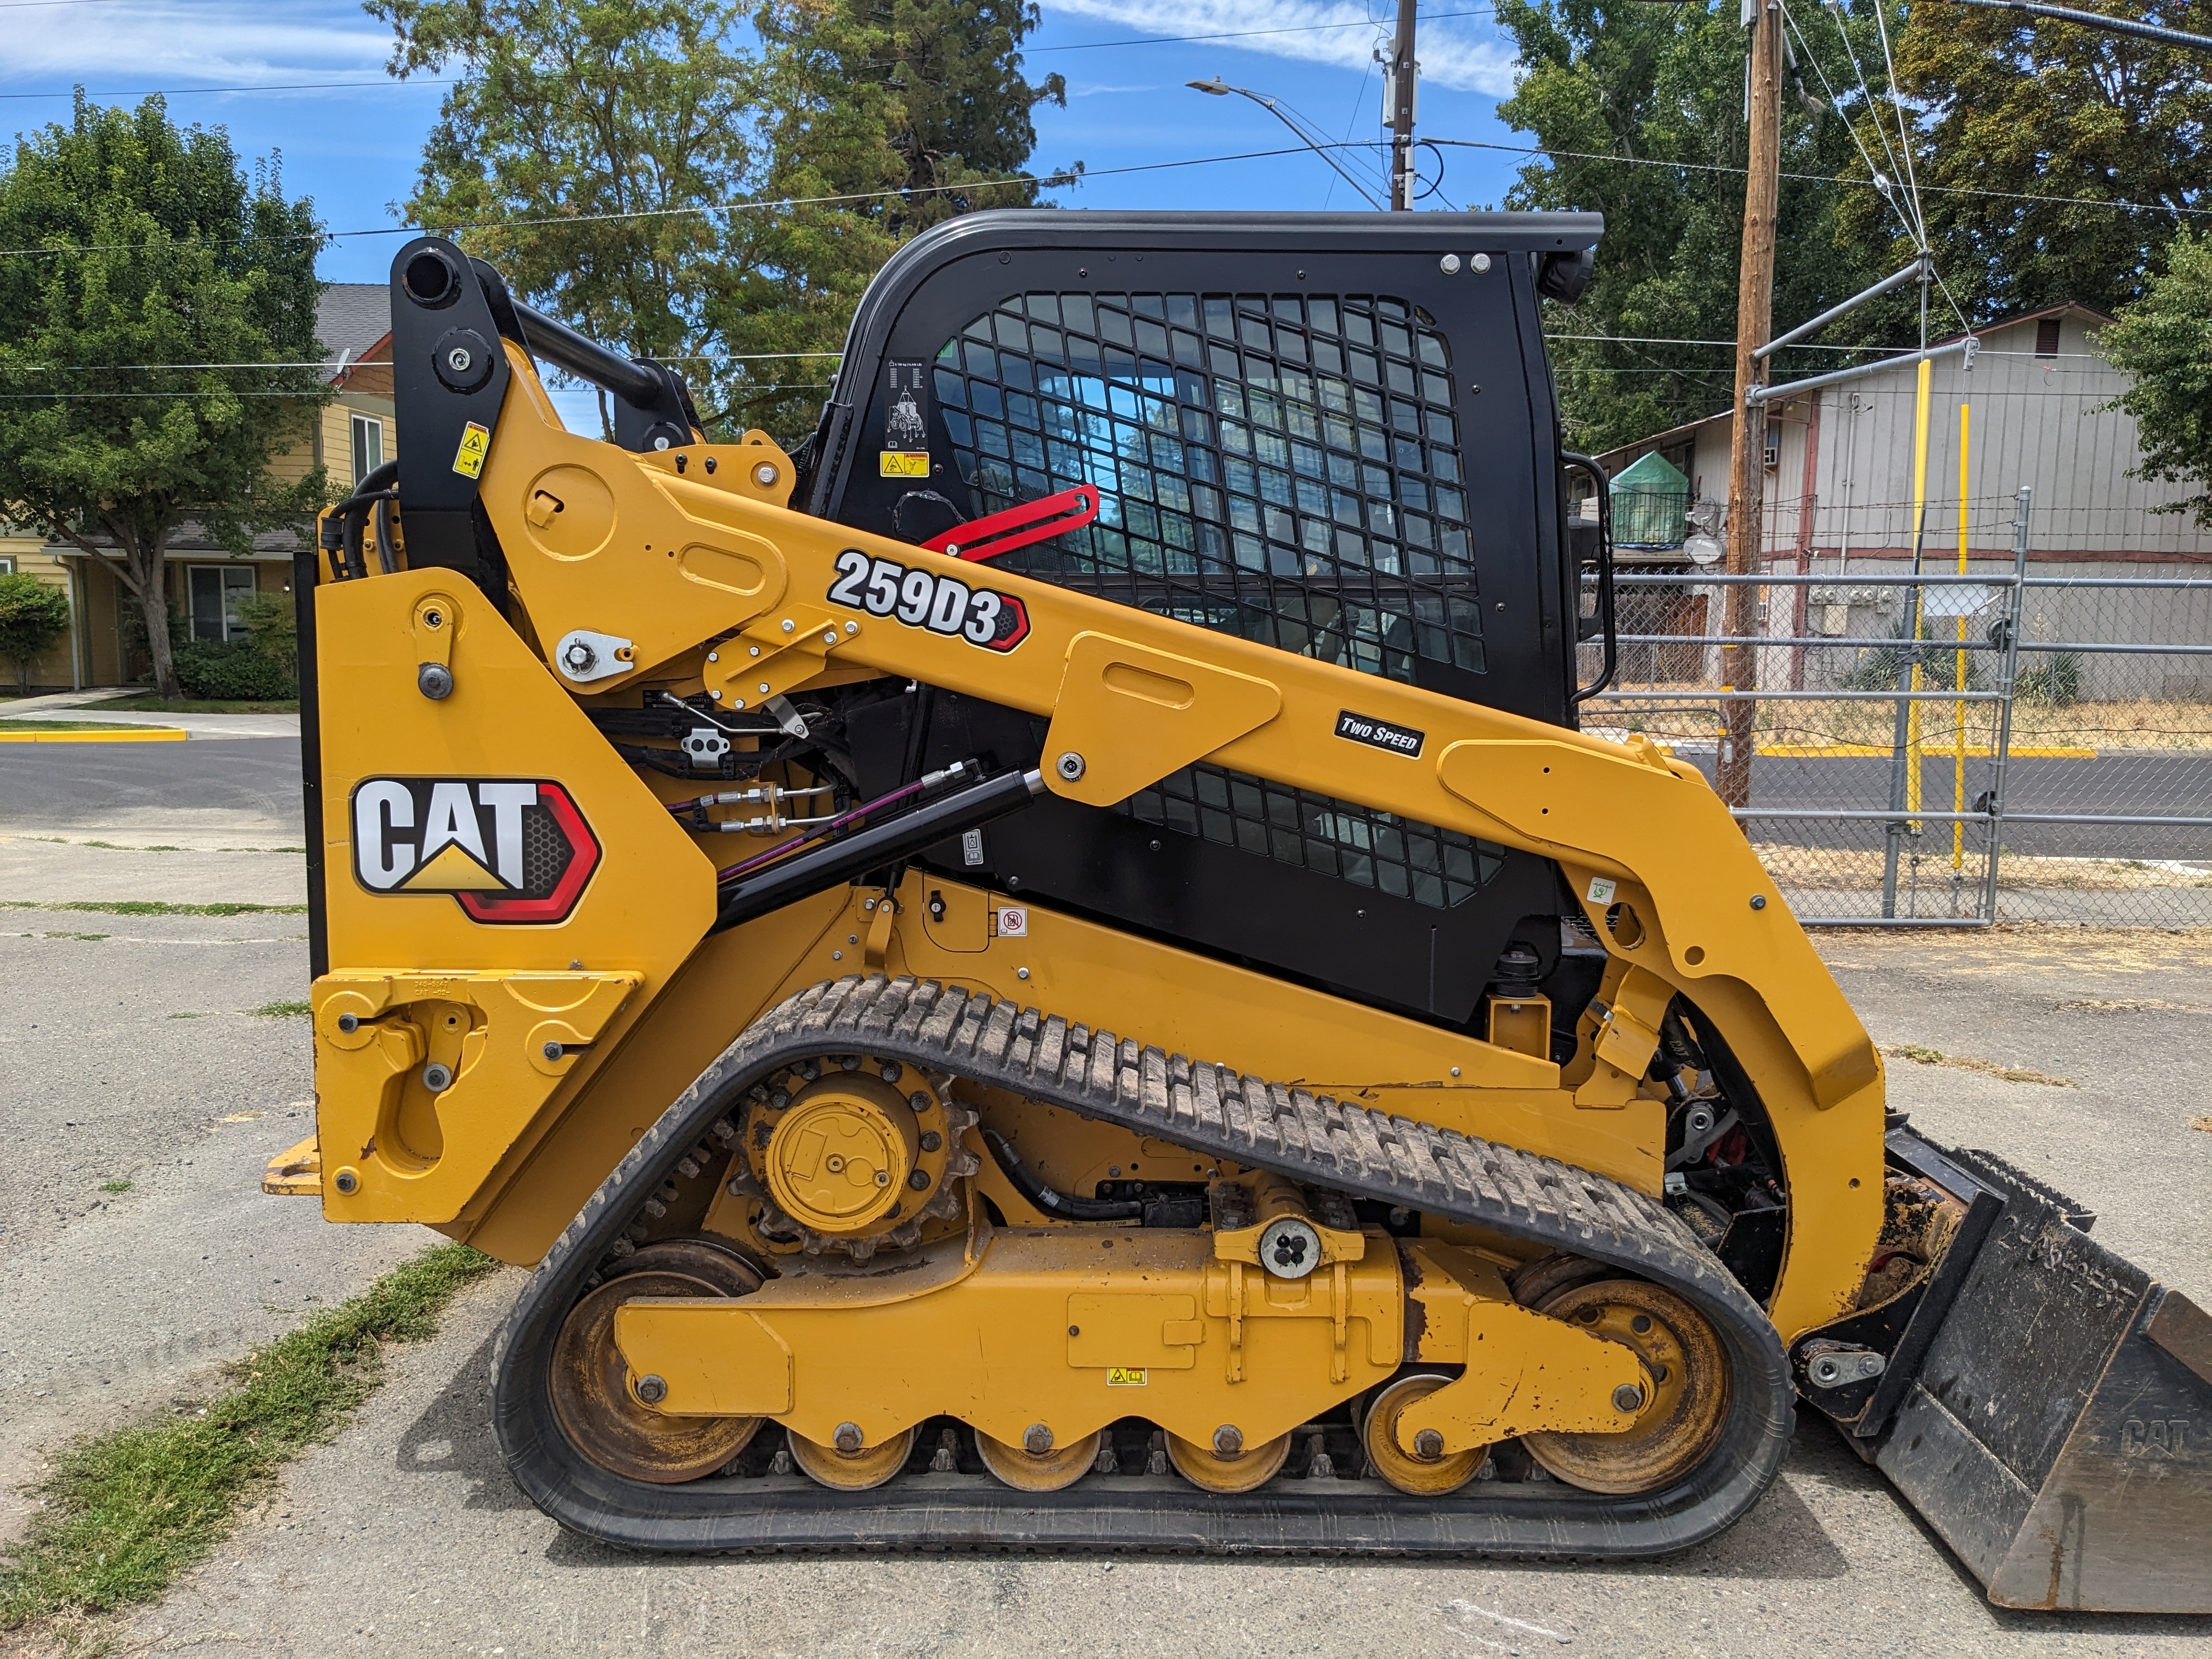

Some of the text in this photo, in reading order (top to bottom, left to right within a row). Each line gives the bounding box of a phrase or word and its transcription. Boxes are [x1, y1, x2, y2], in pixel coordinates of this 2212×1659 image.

[831, 552, 1001, 642] 259D3
[356, 781, 537, 889] CAT
[2121, 1420, 2190, 1456] CAT
